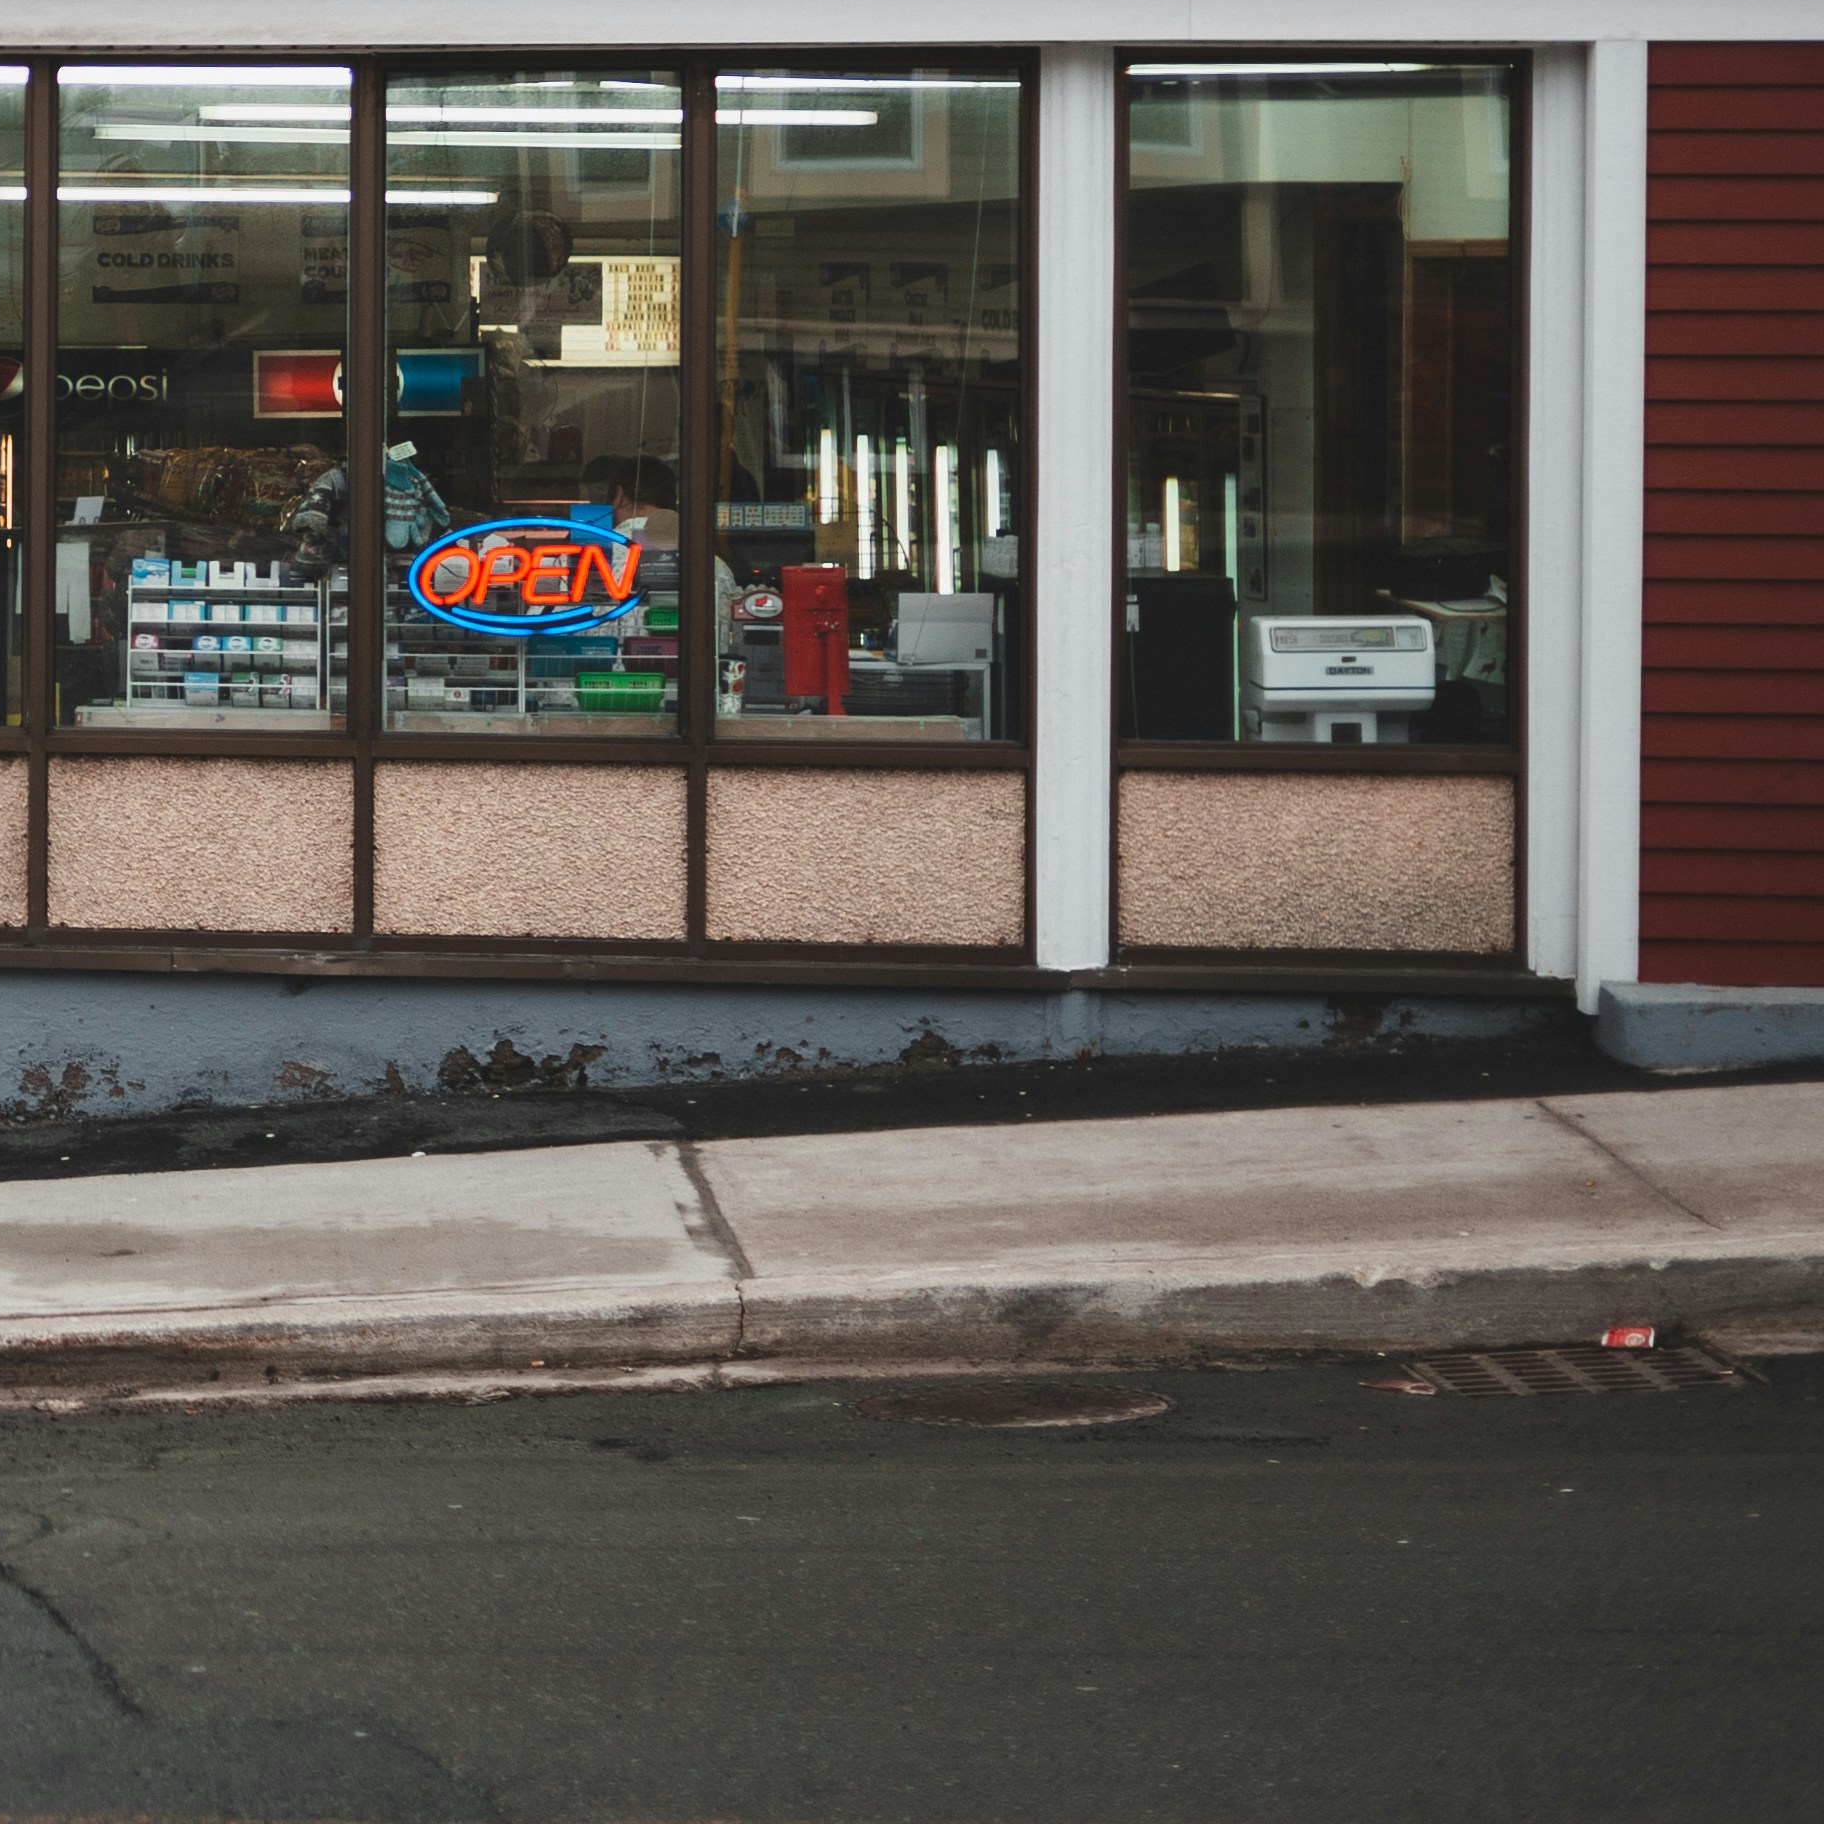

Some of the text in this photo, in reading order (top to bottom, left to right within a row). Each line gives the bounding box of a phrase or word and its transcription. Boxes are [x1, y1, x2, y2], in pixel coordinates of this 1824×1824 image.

[97, 251, 235, 270] COLD DRINKS
[419, 544, 642, 606] OPEN
